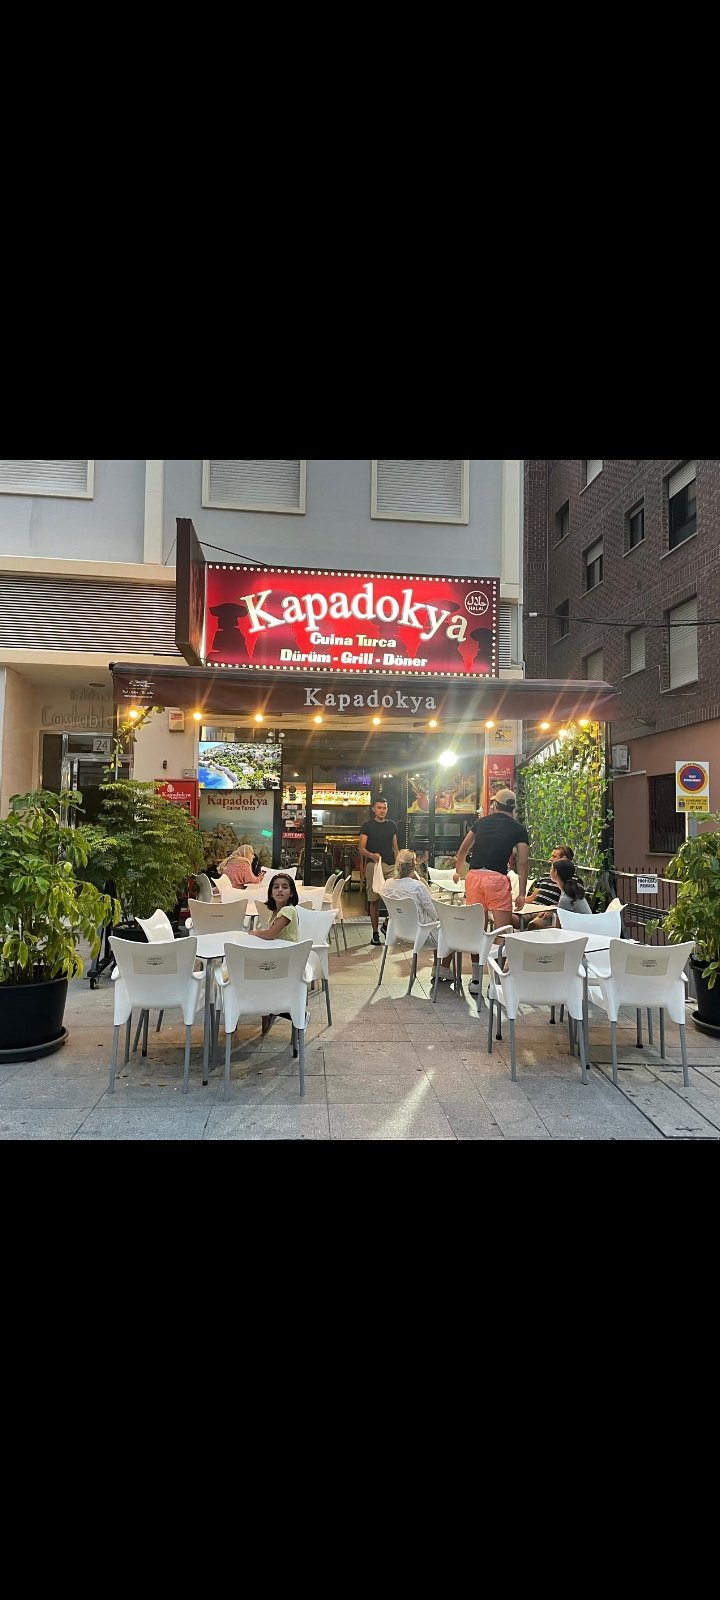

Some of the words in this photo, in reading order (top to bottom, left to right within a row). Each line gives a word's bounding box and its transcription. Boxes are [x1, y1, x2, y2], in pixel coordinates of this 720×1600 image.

[466, 595, 487, 607] حلال
[240, 582, 468, 643] Kapadokya
[310, 632, 353, 646] Cuina
[355, 634, 396, 648] Turca
[280, 649, 331, 663] Dürüm
[341, 651, 373, 665] Grill
[383, 653, 427, 667] Döner
[303, 687, 437, 713] Kapadokya
[96, 740, 108, 751] 24
[207, 795, 268, 809] Kapadokya
